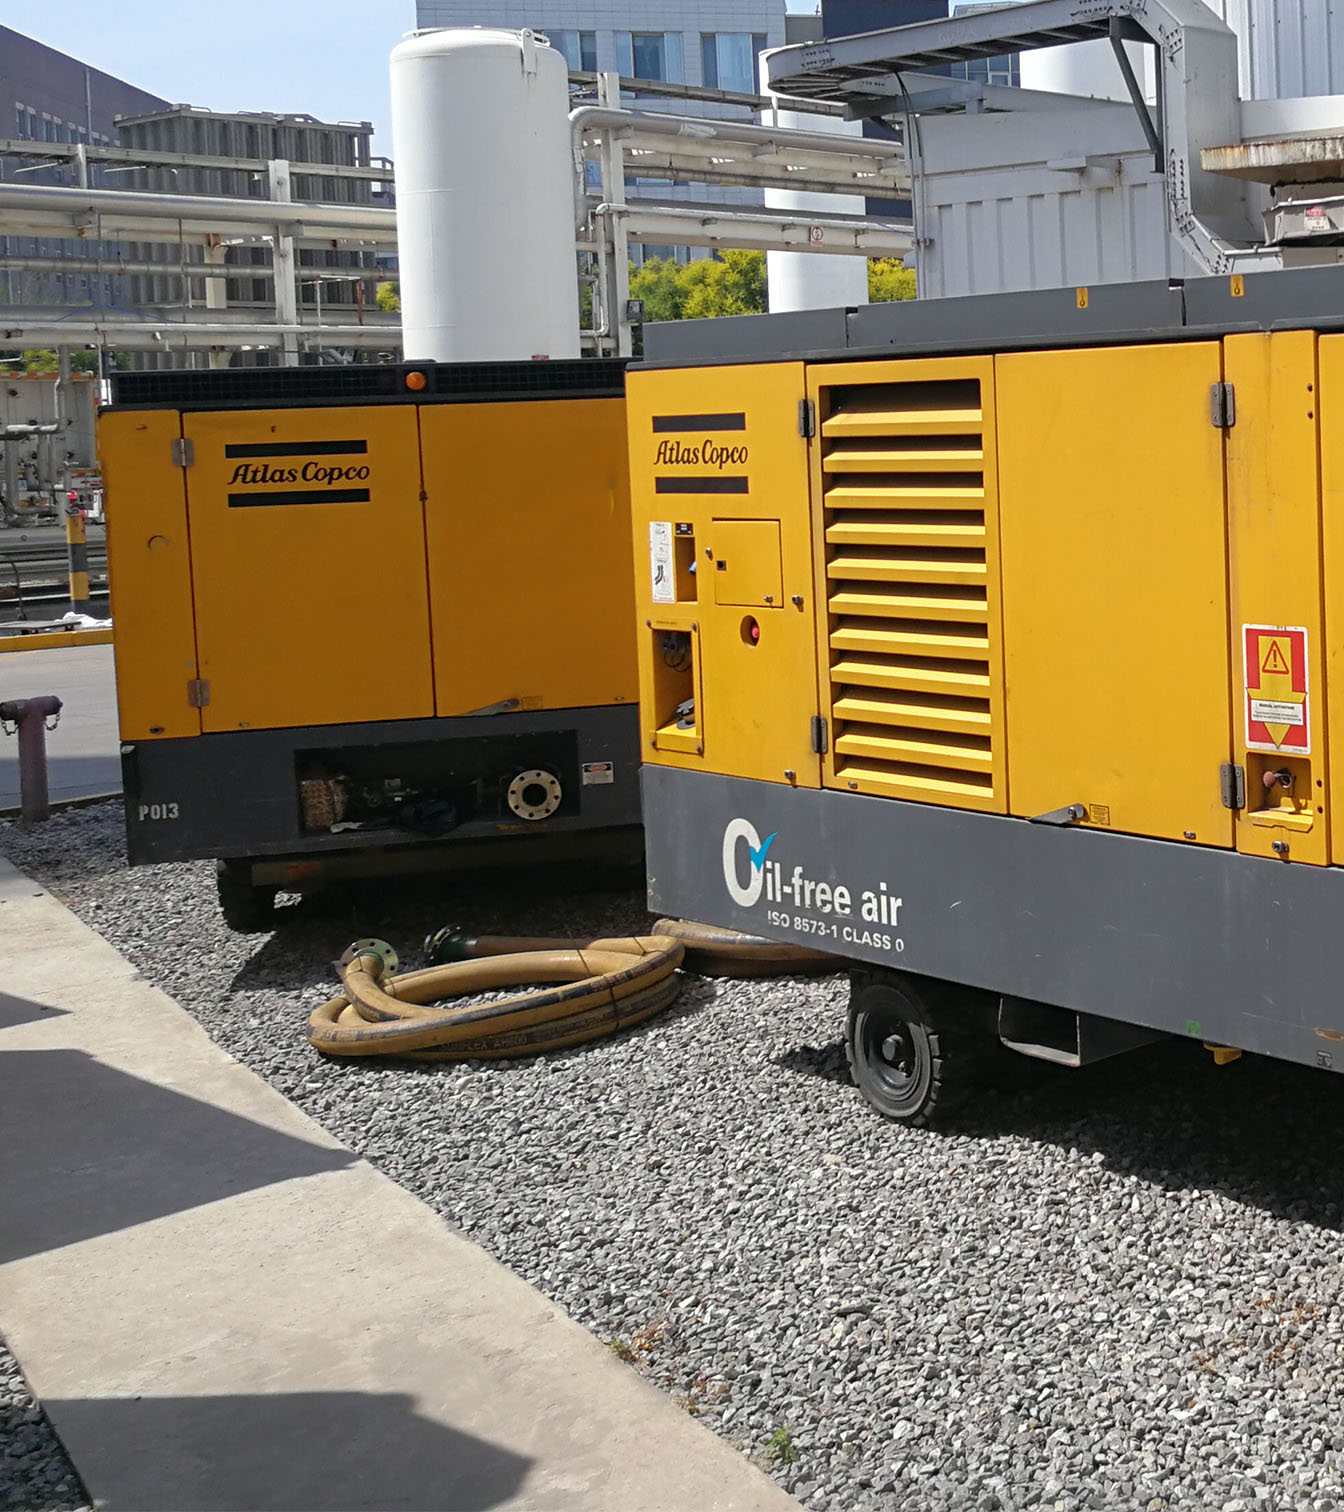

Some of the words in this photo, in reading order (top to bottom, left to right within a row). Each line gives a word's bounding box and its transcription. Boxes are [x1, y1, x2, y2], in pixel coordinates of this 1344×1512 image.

[653, 440, 700, 465] Atlas
[701, 439, 748, 470] Copco
[227, 463, 298, 485] Atlas
[301, 461, 370, 485] Copco
[138, 802, 179, 821] P013
[722, 817, 851, 915] Oil-free
[861, 881, 903, 927] air
[767, 910, 790, 928] ISO
[793, 916, 838, 939] 8573-1
[842, 926, 892, 951] CLASS
